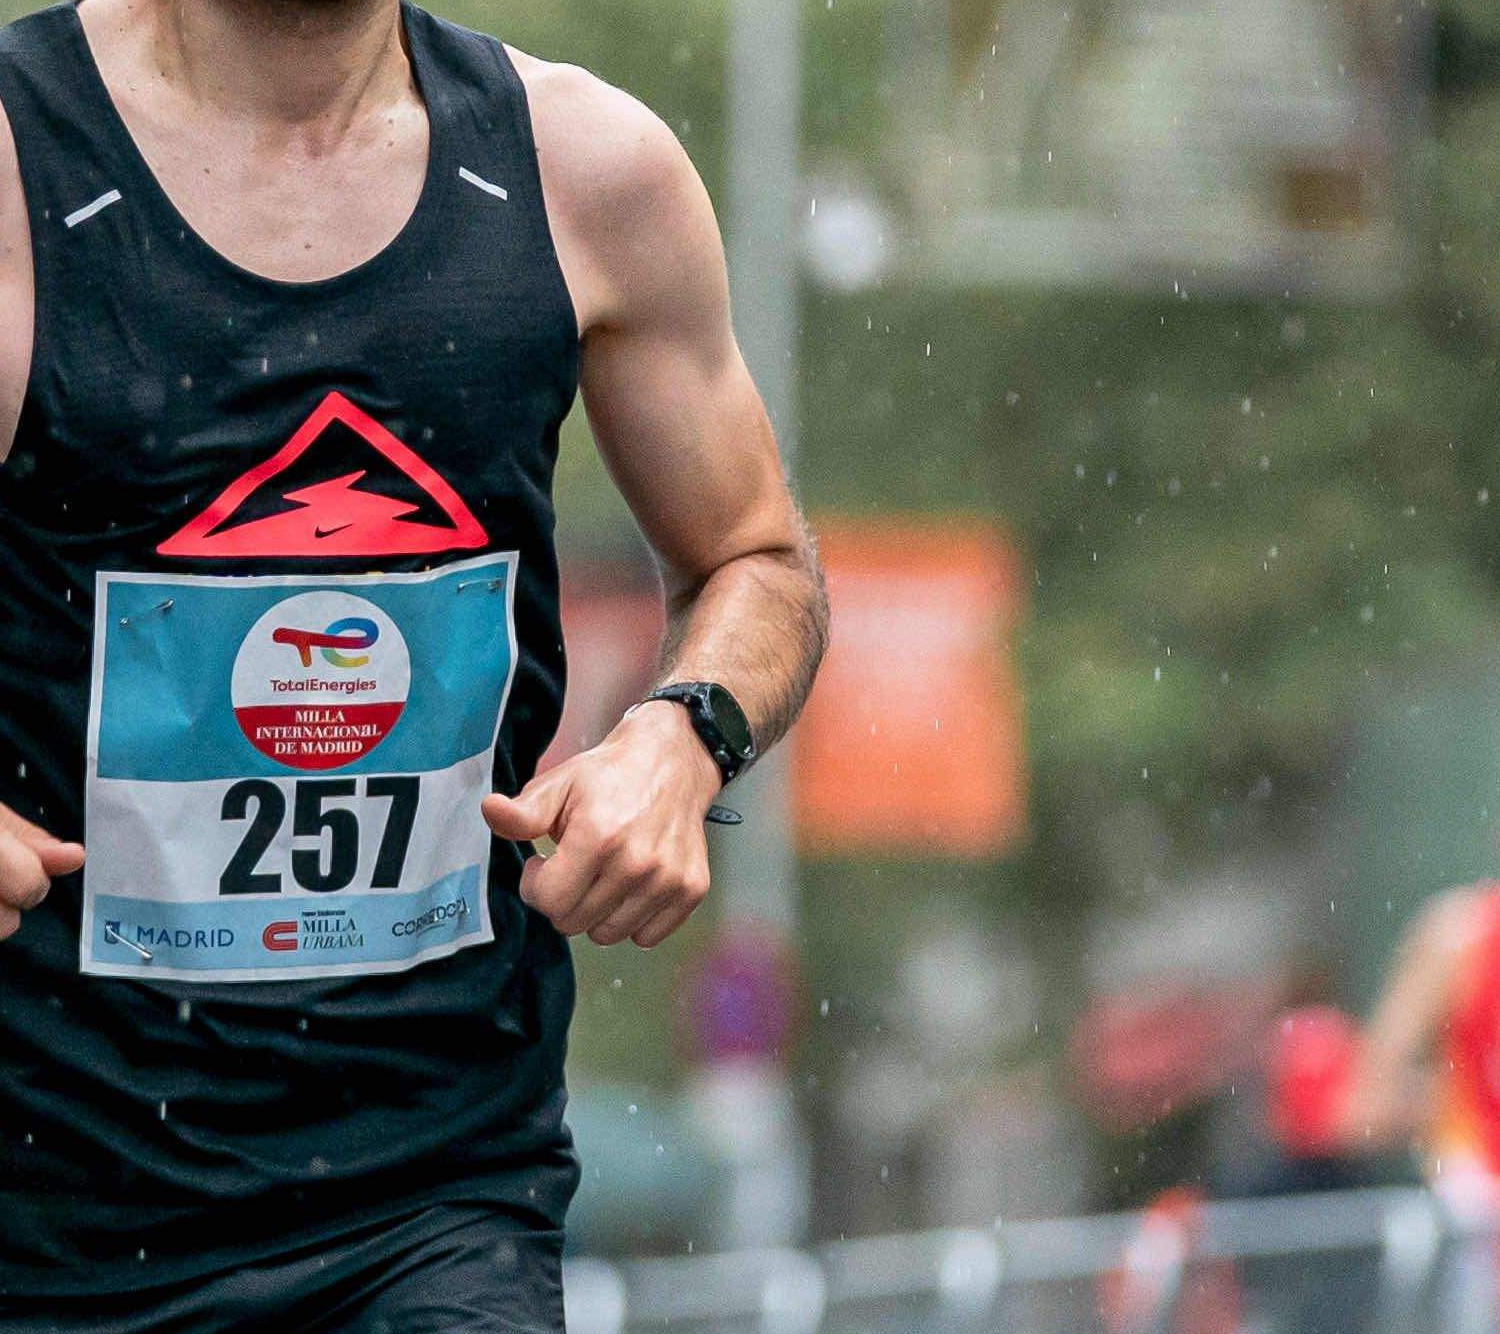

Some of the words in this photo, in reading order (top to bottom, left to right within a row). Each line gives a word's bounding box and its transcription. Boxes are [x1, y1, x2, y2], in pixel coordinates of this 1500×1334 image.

[270, 678, 377, 694] TotalEnergies
[295, 710, 345, 723] MILLA
[274, 741, 297, 755] DE
[300, 740, 363, 754] MADRID
[219, 776, 420, 896] 257
[302, 918, 356, 933] MILLA
[137, 926, 234, 948] MADRID
[303, 934, 363, 949] URBANA
